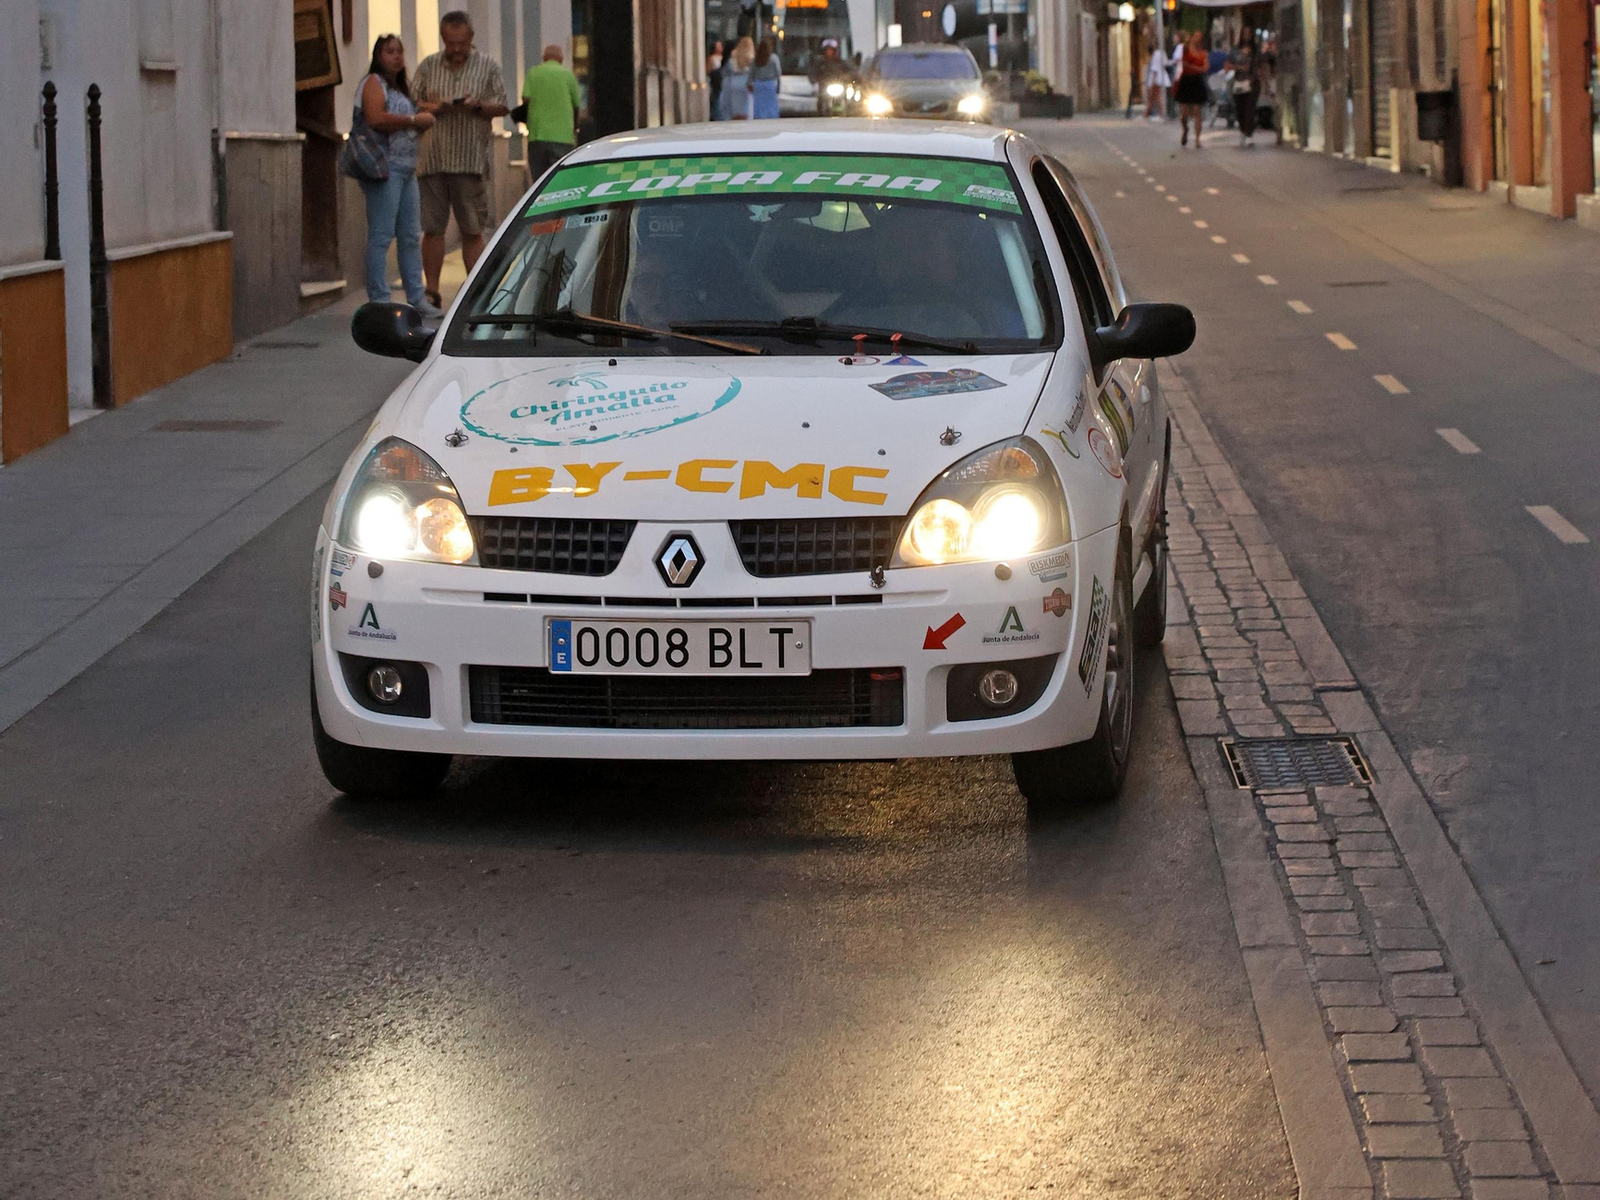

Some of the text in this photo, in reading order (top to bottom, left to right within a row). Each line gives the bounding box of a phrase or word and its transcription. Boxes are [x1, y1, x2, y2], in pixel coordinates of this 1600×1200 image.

[586, 170, 784, 198] COPA
[792, 170, 943, 193] FAA
[509, 381, 688, 420] Chiringuito
[544, 393, 677, 425] Amalia
[487, 458, 891, 507] BY-CMC
[576, 626, 794, 669] 0008 BLT
[1011, 632, 1040, 642] Andalucía
[556, 652, 567, 664] E
